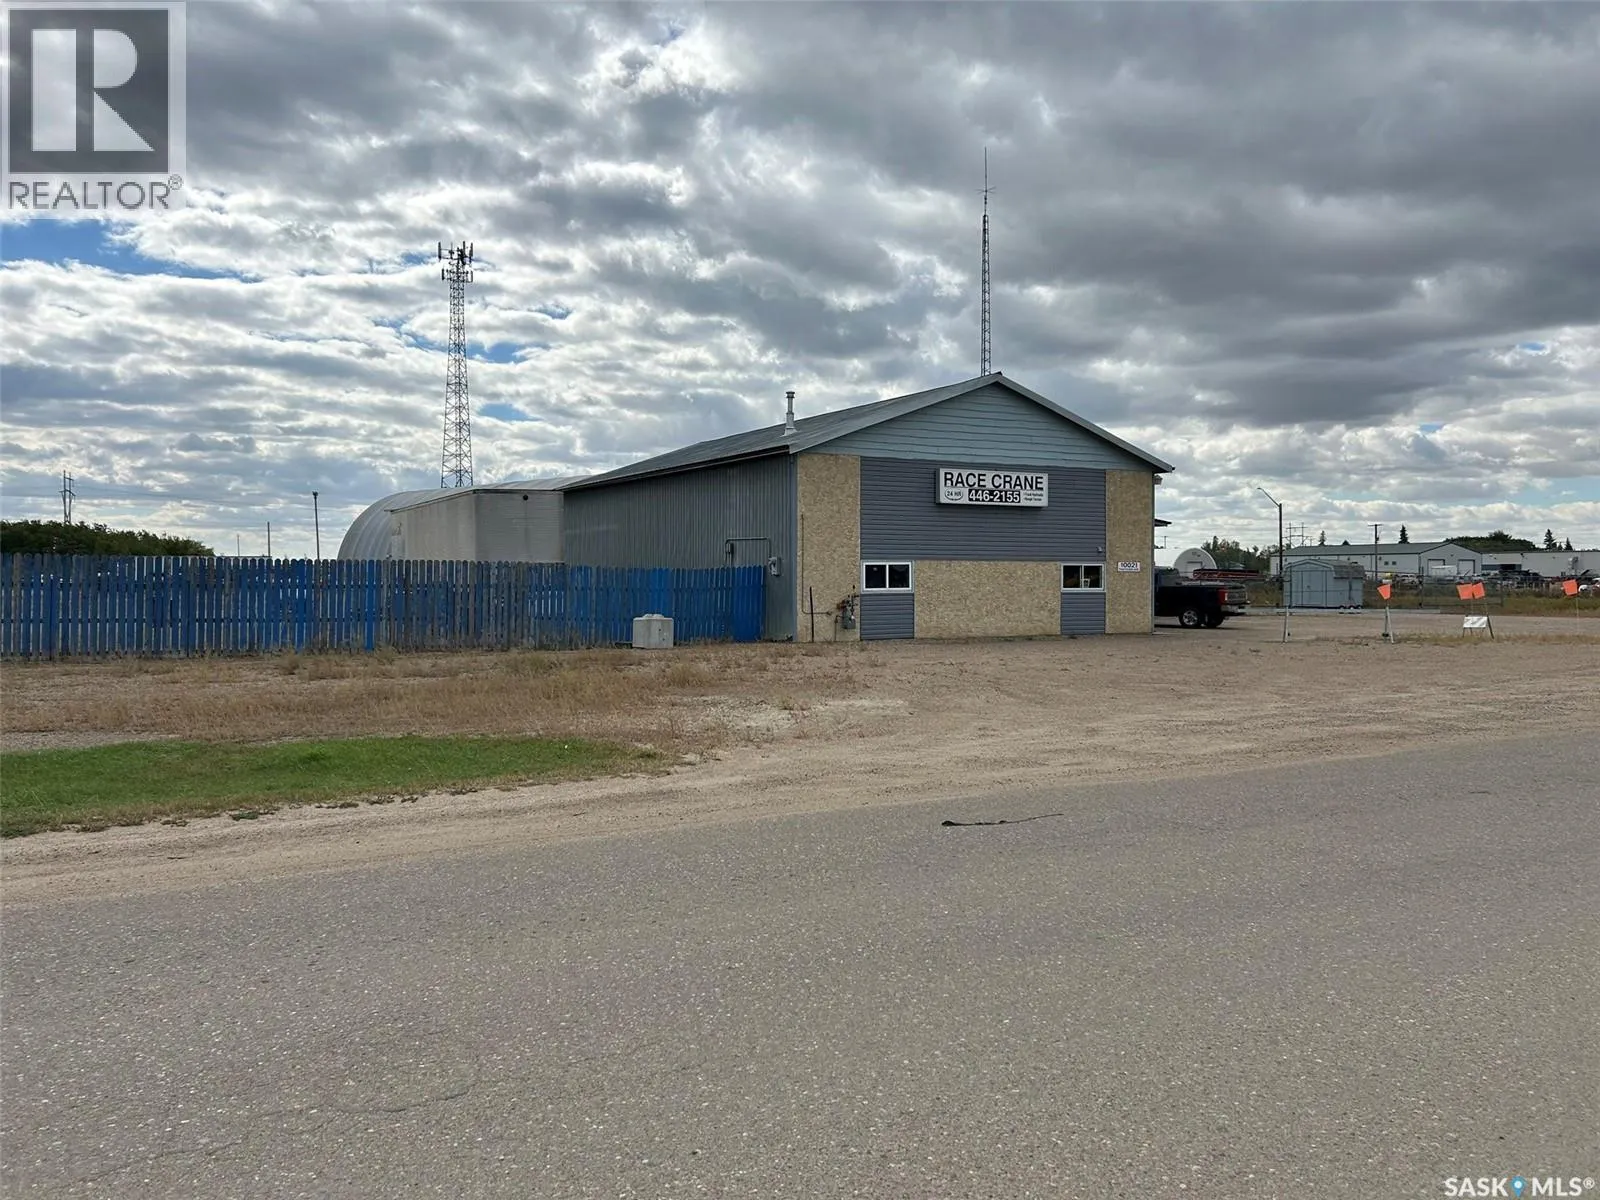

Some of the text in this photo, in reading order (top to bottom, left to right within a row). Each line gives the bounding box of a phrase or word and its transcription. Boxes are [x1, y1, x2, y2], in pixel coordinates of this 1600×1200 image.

[944, 471, 1044, 490] RACE CRANE
[968, 489, 1020, 503] 446-2155
